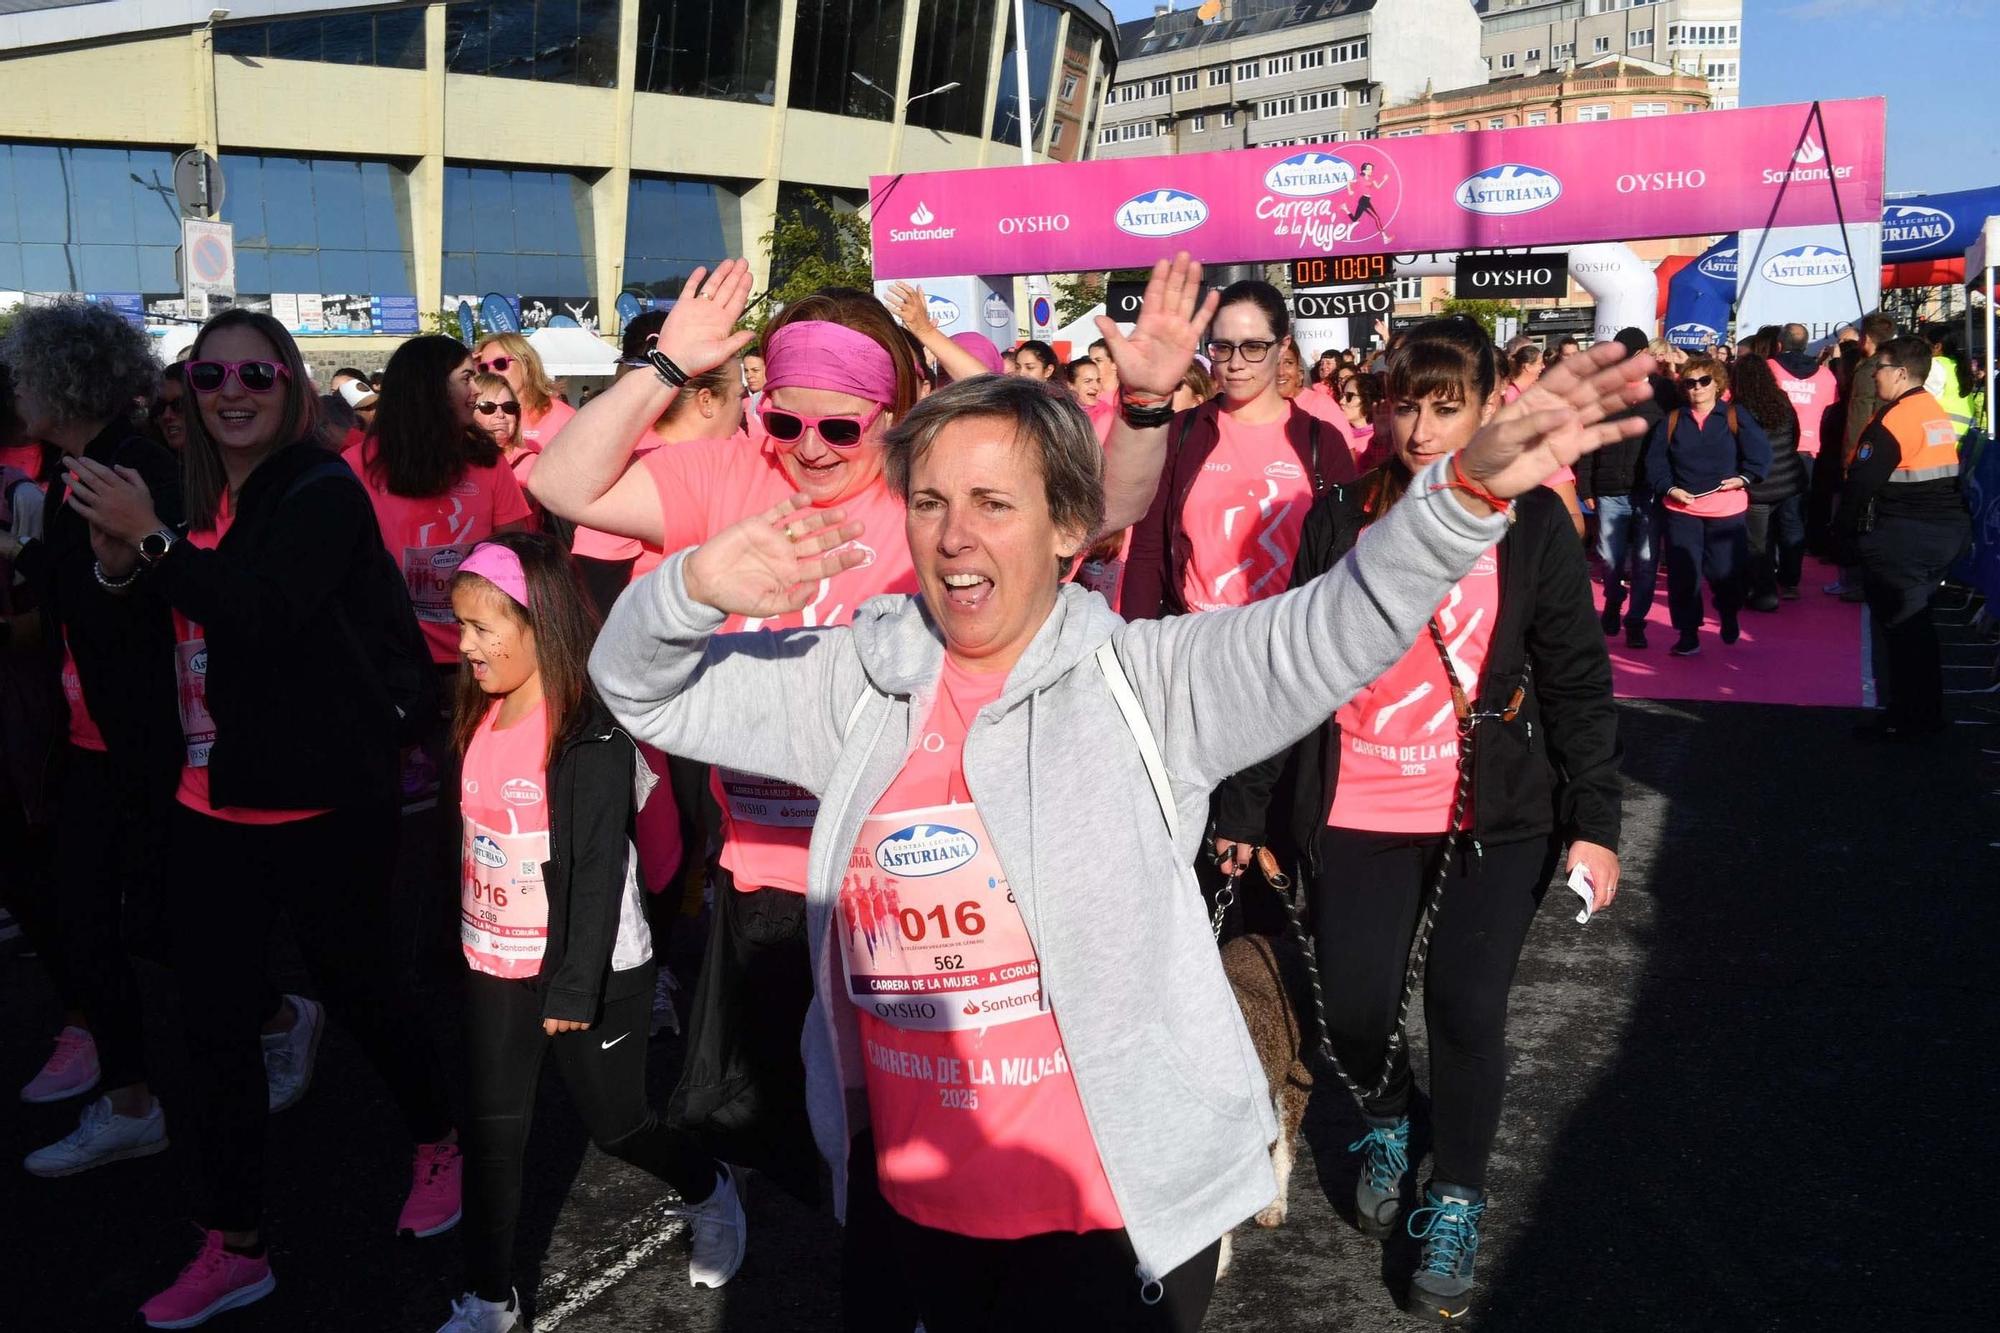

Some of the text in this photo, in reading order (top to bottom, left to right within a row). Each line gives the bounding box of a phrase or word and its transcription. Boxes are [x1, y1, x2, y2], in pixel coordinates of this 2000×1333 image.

[1271, 171, 1348, 187] ASTURIANA
[1616, 169, 1706, 193] OYSHO
[1762, 165, 1853, 184] Santander
[1463, 185, 1552, 203] ASTURIANA
[1256, 196, 1332, 219] Carrera
[998, 214, 1070, 234] OYSHO
[1122, 209, 1201, 227] ASTURIANA
[890, 227, 956, 242] Santander
[1274, 214, 1360, 251] de la Mujer
[1297, 255, 1384, 283] 00:10:09
[1575, 262, 1621, 273] OYSHO
[1768, 262, 1848, 278] ASTURIANA
[1471, 268, 1552, 287] OYSHO
[1298, 291, 1390, 316] OYSHO
[1352, 737, 1396, 761] CARRERA
[1400, 746, 1417, 762] DE
[1421, 745, 1437, 761] LA
[1401, 764, 1427, 777] 2025
[883, 843, 970, 867] ASTURIANA
[474, 879, 508, 907] 016
[899, 900, 986, 942] 016
[500, 943, 542, 953] Santander
[934, 954, 965, 971] 562
[870, 979, 910, 991] CARRERA
[911, 980, 925, 991] DE
[927, 978, 941, 989] LA
[943, 975, 979, 988] MUJER
[989, 972, 998, 982] A
[875, 1002, 936, 1019] OYSHO
[867, 1040, 1068, 1087] CARRERA DE LA MUJER
[939, 1088, 979, 1111] 2025
